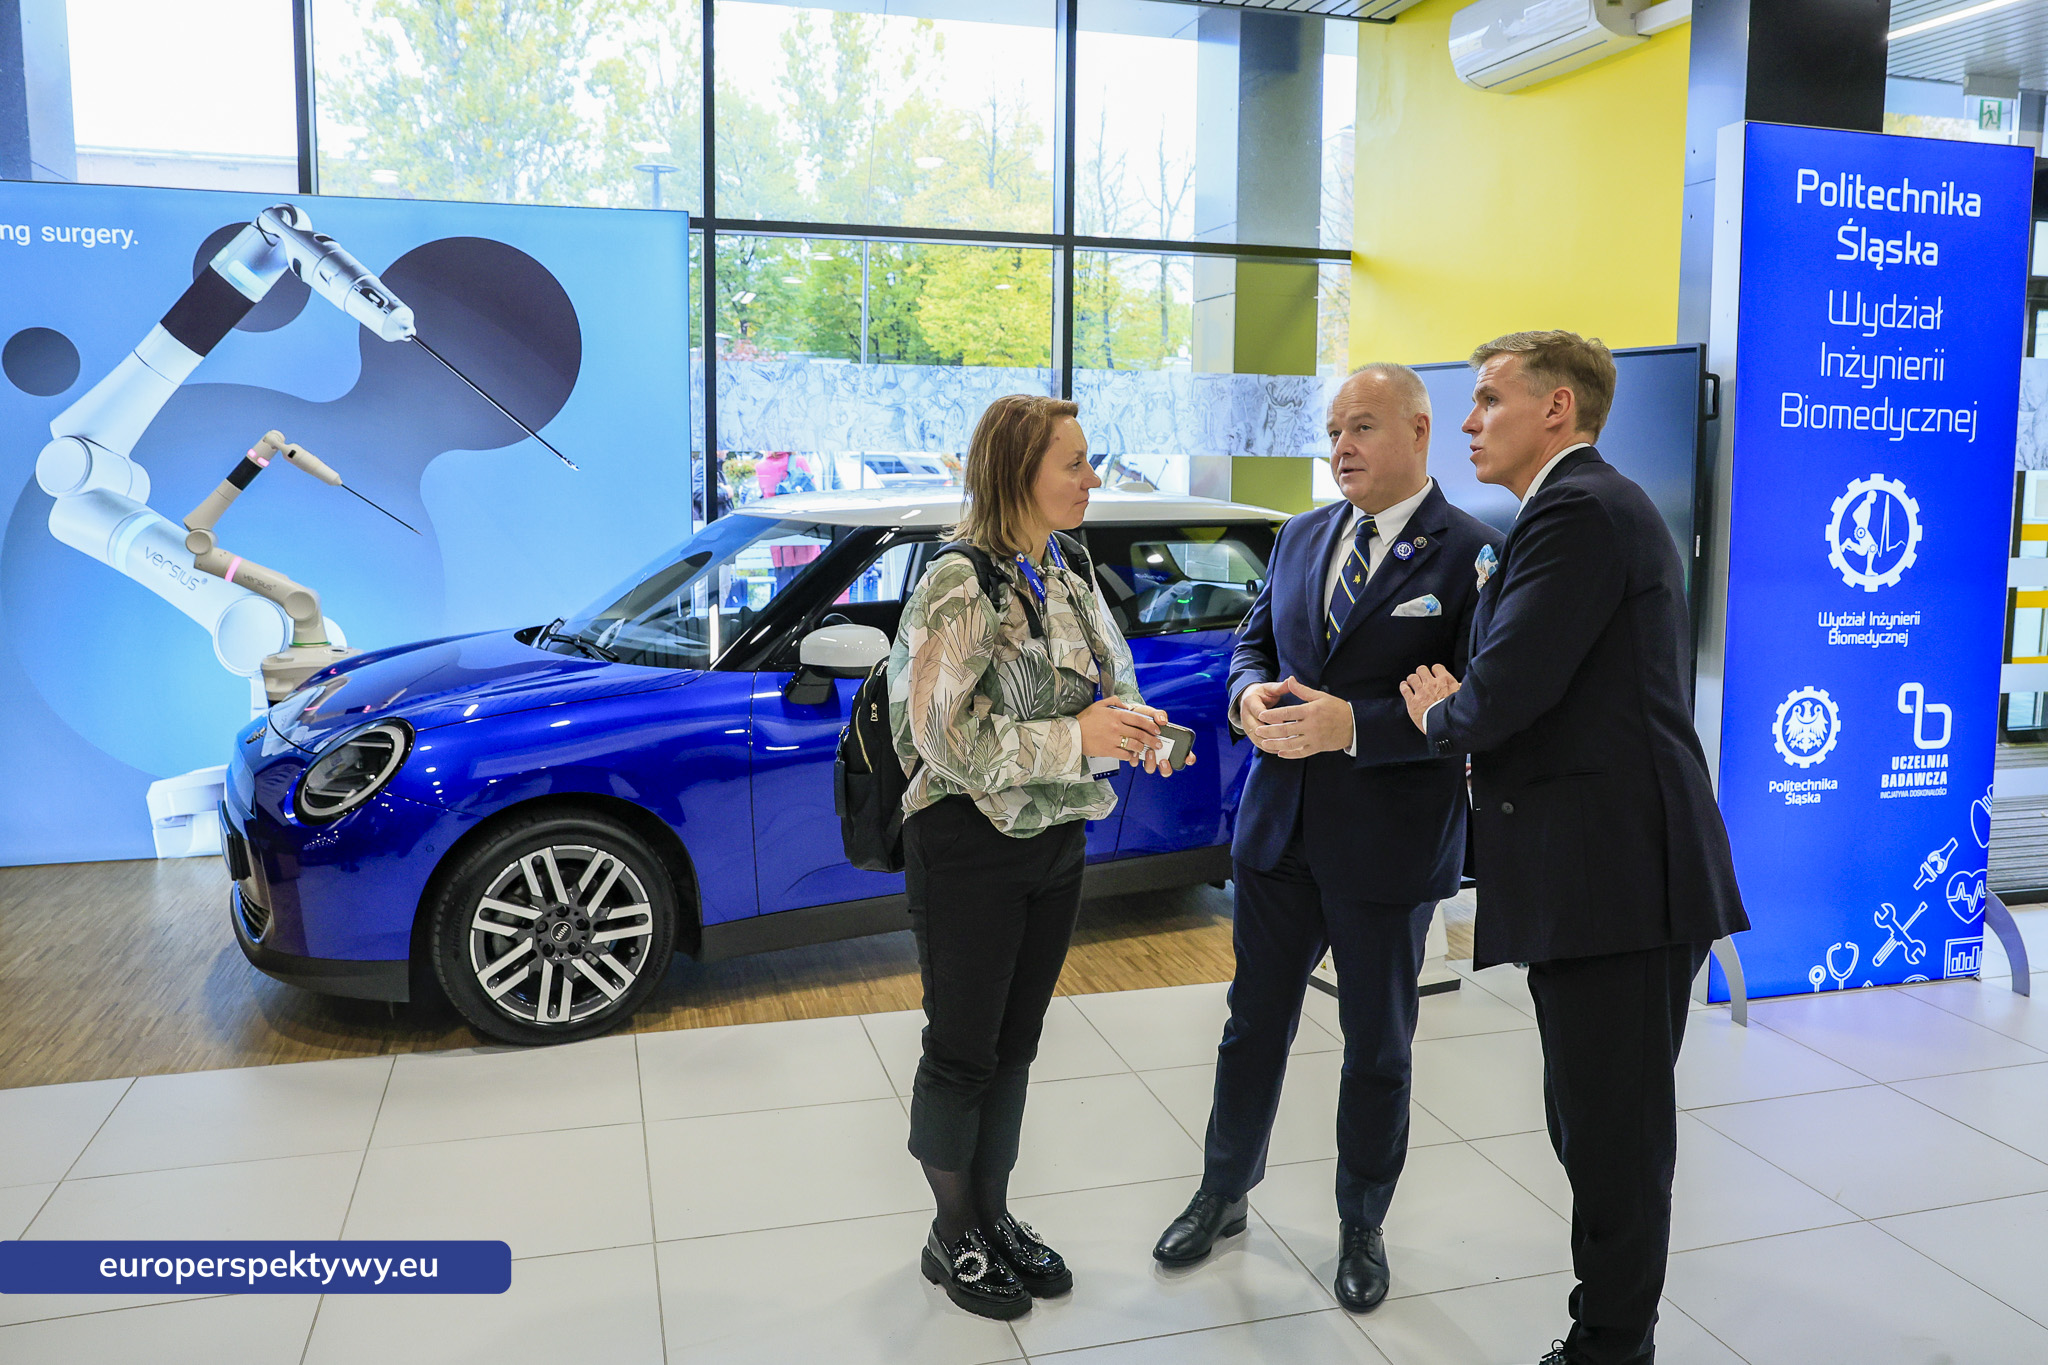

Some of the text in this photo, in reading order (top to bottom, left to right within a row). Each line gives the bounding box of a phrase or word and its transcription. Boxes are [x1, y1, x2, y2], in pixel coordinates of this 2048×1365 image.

[1797, 168, 1981, 218] Politechnika
[41, 226, 139, 250] surgery.
[1836, 218, 1939, 271] Śląska
[1828, 289, 1944, 337] Wydział
[1820, 341, 1945, 389] Inżynierii
[1780, 392, 1978, 443] Biomedycznej
[1818, 610, 1921, 630] Wydział Inżynierii
[1828, 629, 1909, 648] Biomedycznej
[1891, 753, 1949, 770] UCZELNIA
[1768, 777, 1838, 793] Politechnika
[1881, 771, 1948, 788] BADAWCZA
[1785, 791, 1821, 806] Śląska
[555, 924, 569, 941] MINI
